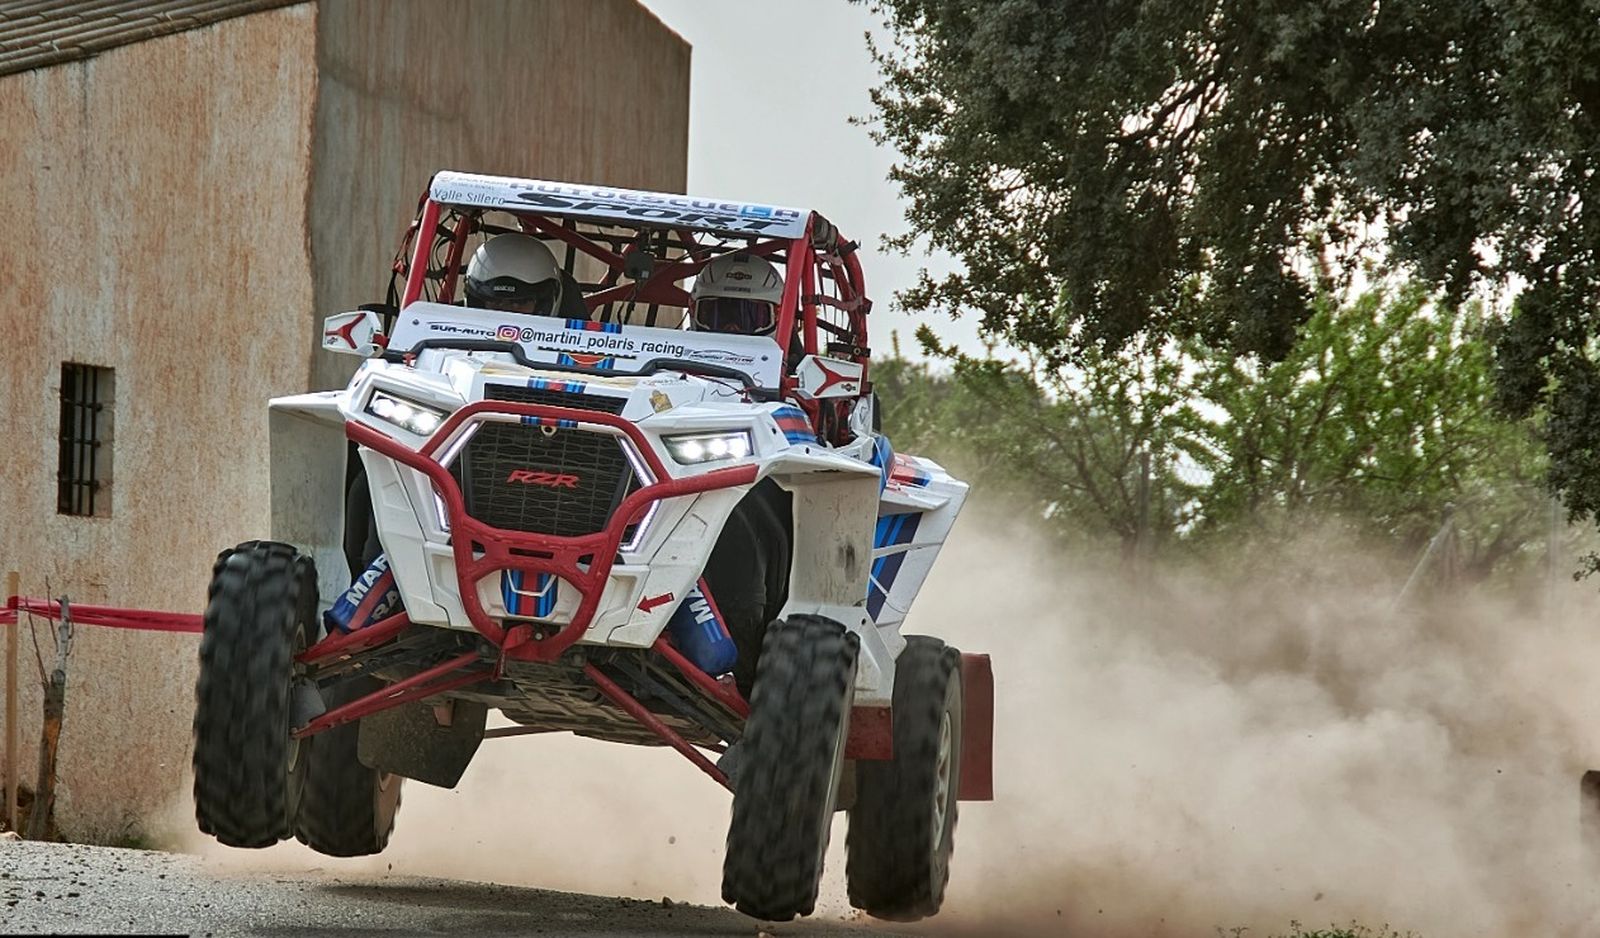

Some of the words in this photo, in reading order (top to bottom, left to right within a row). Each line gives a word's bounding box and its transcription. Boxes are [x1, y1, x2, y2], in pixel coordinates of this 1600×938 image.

[434, 188, 463, 201] Valle
[466, 191, 506, 206] Sillero
[502, 192, 791, 231] SPORT
[519, 327, 685, 358] @martini_polaris_racing
[506, 469, 580, 490] RZR
